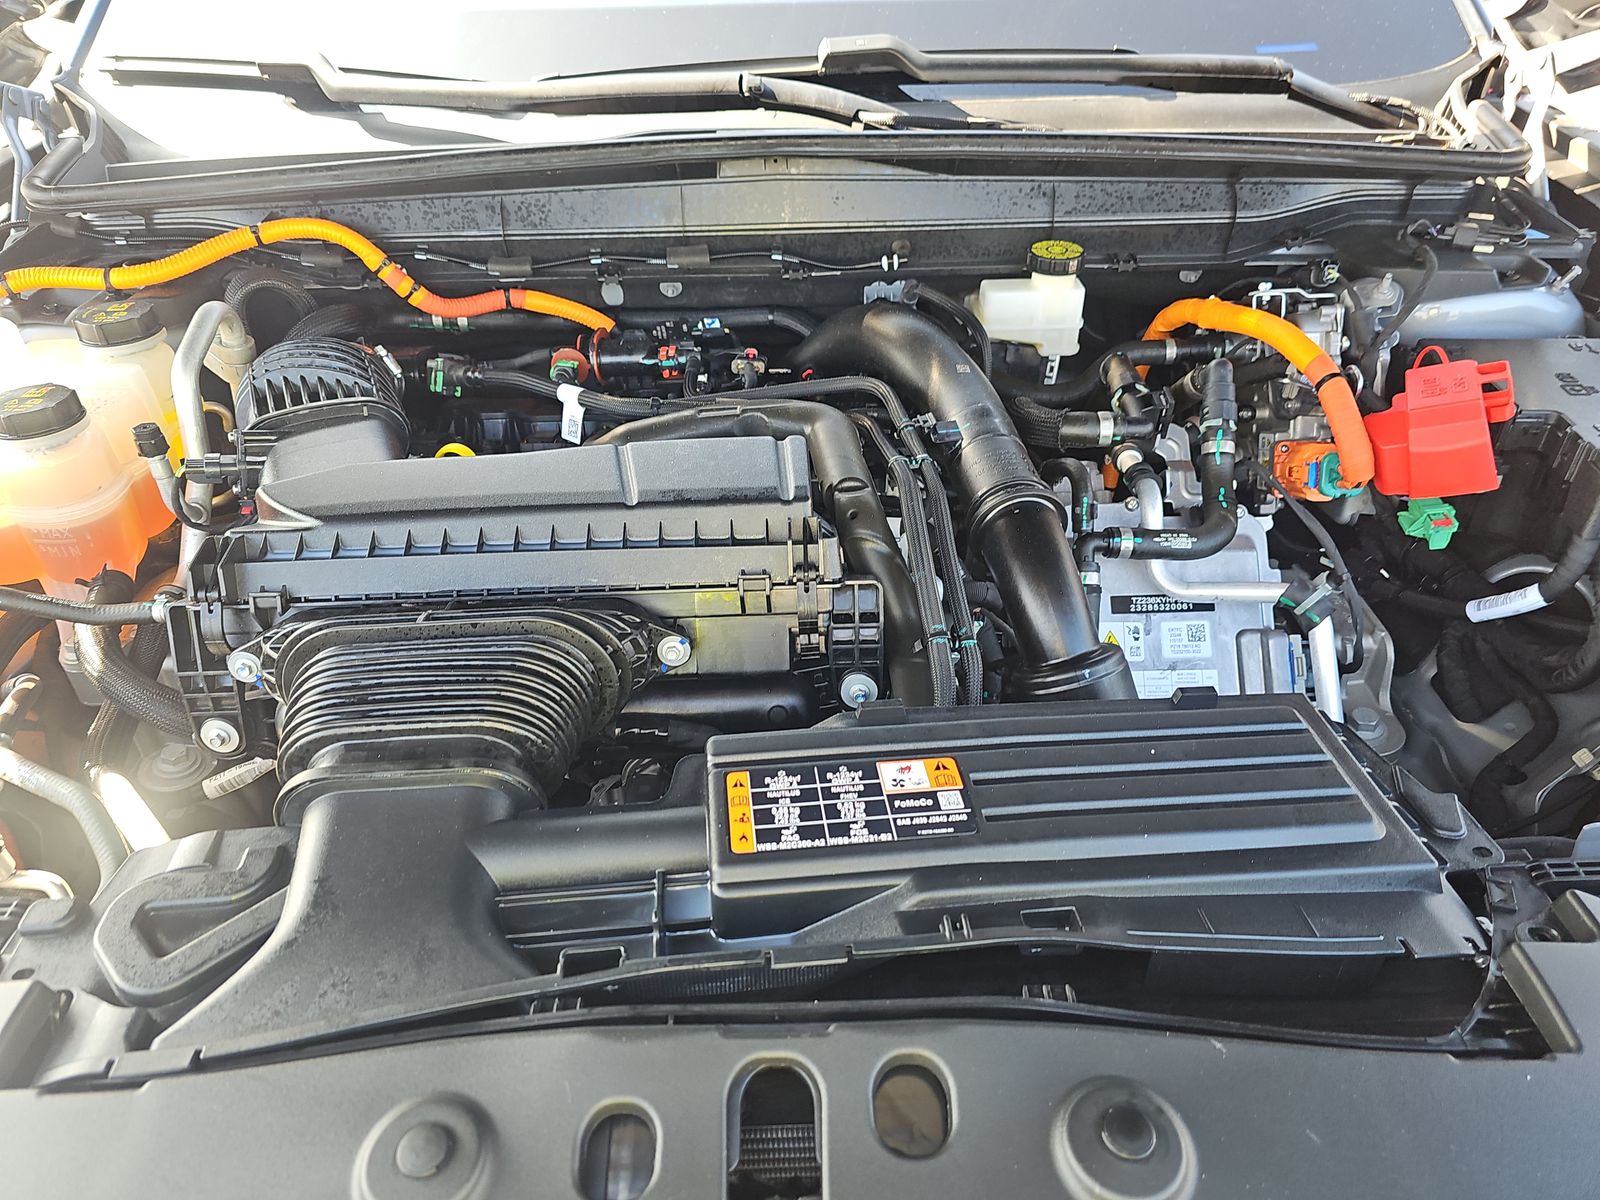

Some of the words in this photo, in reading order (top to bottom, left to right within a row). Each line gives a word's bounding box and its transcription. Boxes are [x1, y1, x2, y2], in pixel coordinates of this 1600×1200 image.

[47, 545, 82, 557] MIN
[767, 789, 801, 798] NAUTILUS
[831, 784, 865, 793] NAUTILUS
[894, 797, 933, 809] FoMoCo
